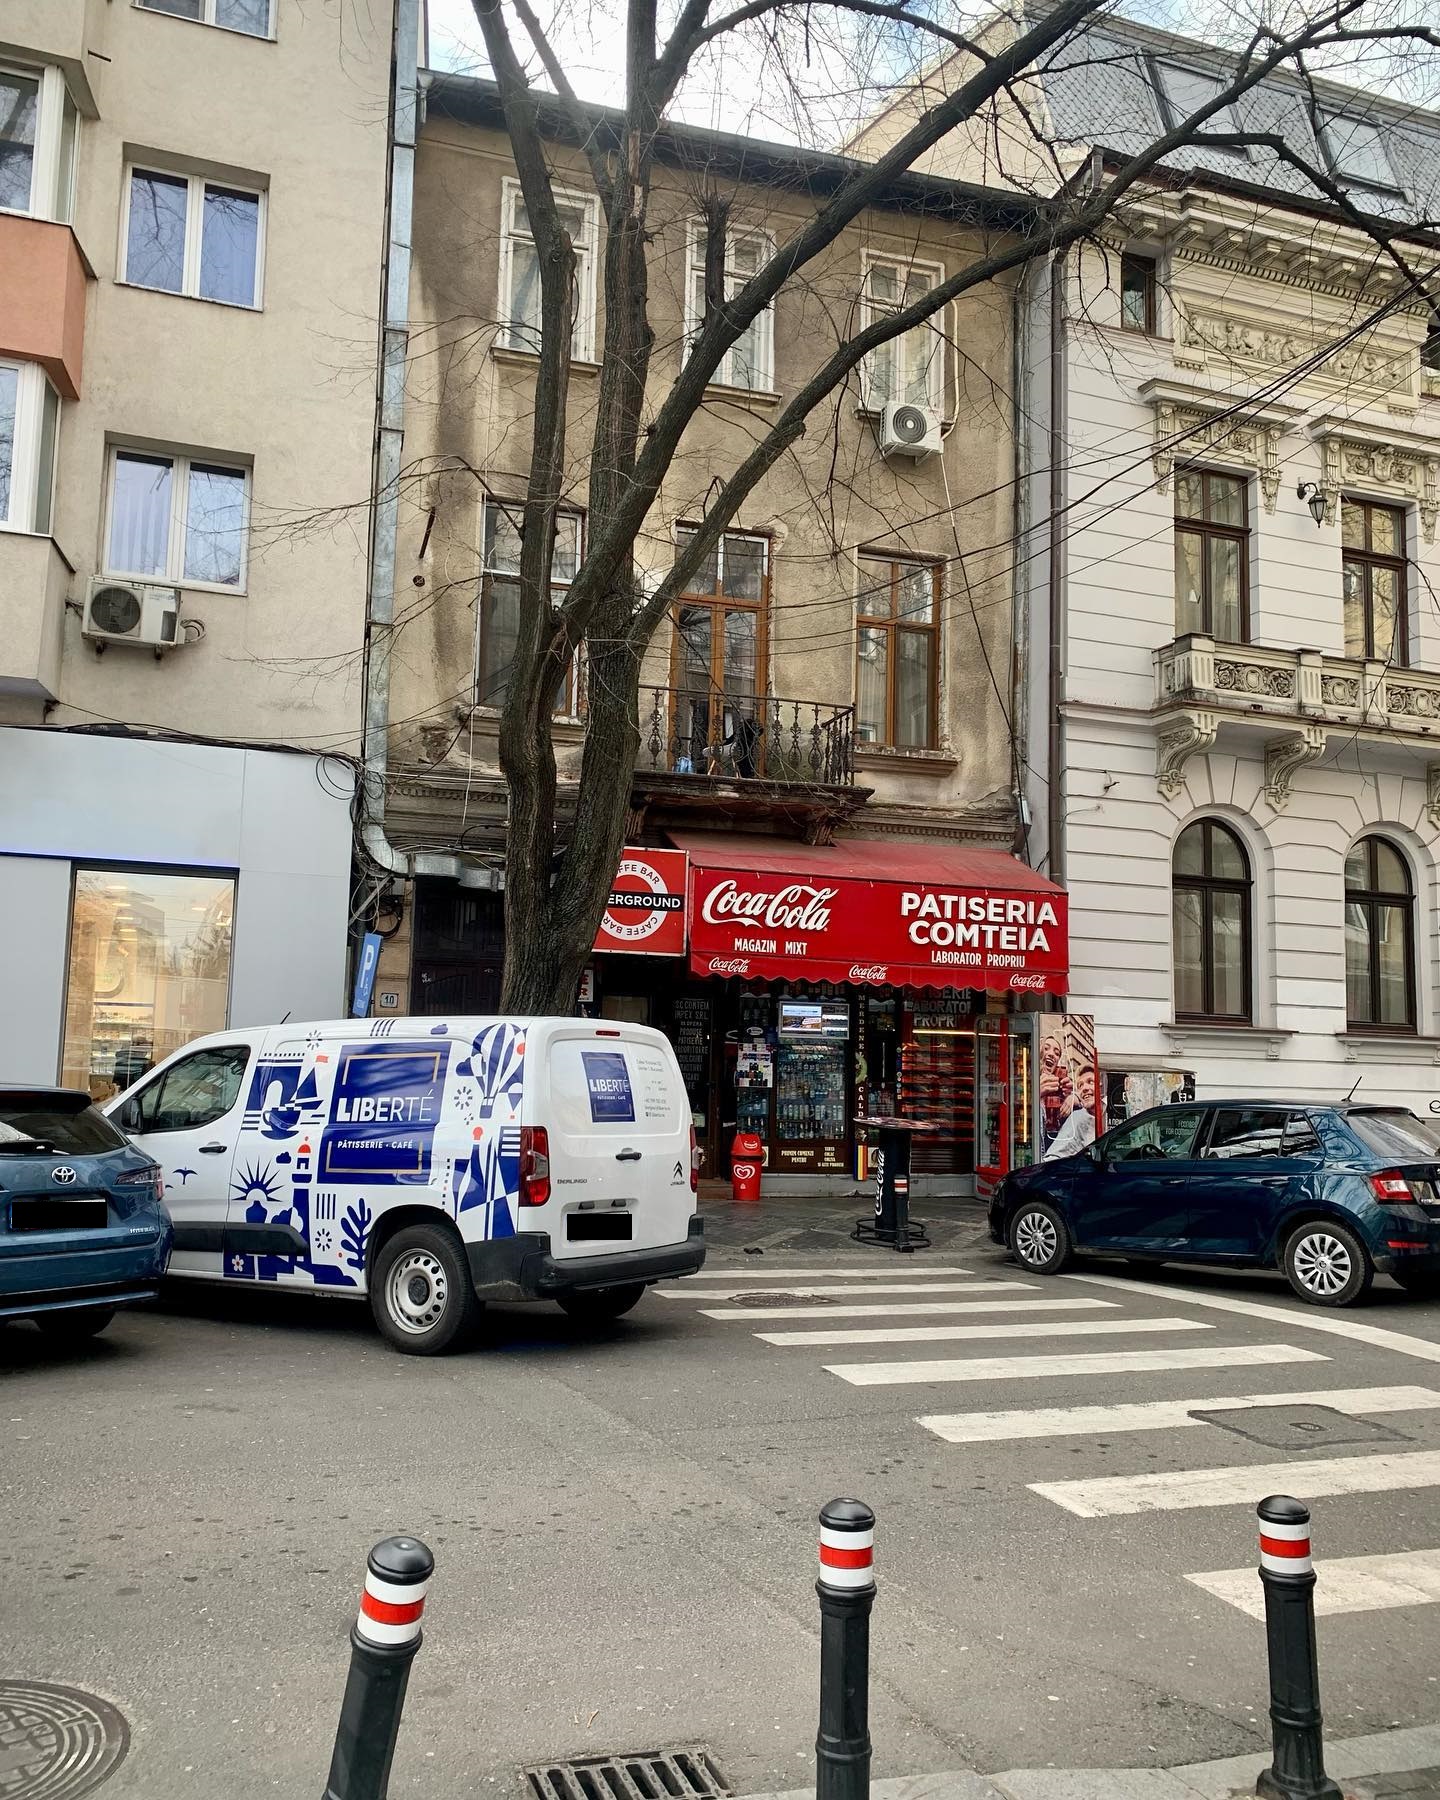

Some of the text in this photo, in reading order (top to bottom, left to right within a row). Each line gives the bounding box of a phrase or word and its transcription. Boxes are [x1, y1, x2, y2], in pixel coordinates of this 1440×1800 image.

[616, 864, 660, 885] FFE BAR
[608, 893, 681, 909] ERGROUND
[701, 879, 839, 931] Coca-Cola
[901, 892, 1059, 926] PATISERIA
[602, 915, 658, 936] CAFFE BAR
[908, 920, 1050, 952] COMTEIA
[734, 937, 808, 955] MAGAZIN MIXT
[708, 957, 750, 973] Coca-Cola
[931, 950, 1026, 968] LABORATOR PROPRIU
[848, 964, 888, 980] Coca-Cola
[1009, 973, 1047, 989] Coca-Cola
[384, 995, 395, 1004] 10
[588, 1072, 630, 1093] LIBERTÉ
[336, 1088, 434, 1122] LIBERTÉ
[857, 1086, 865, 1118] CALD
[337, 1139, 413, 1149] PÂTISSERIE CAFÉ
